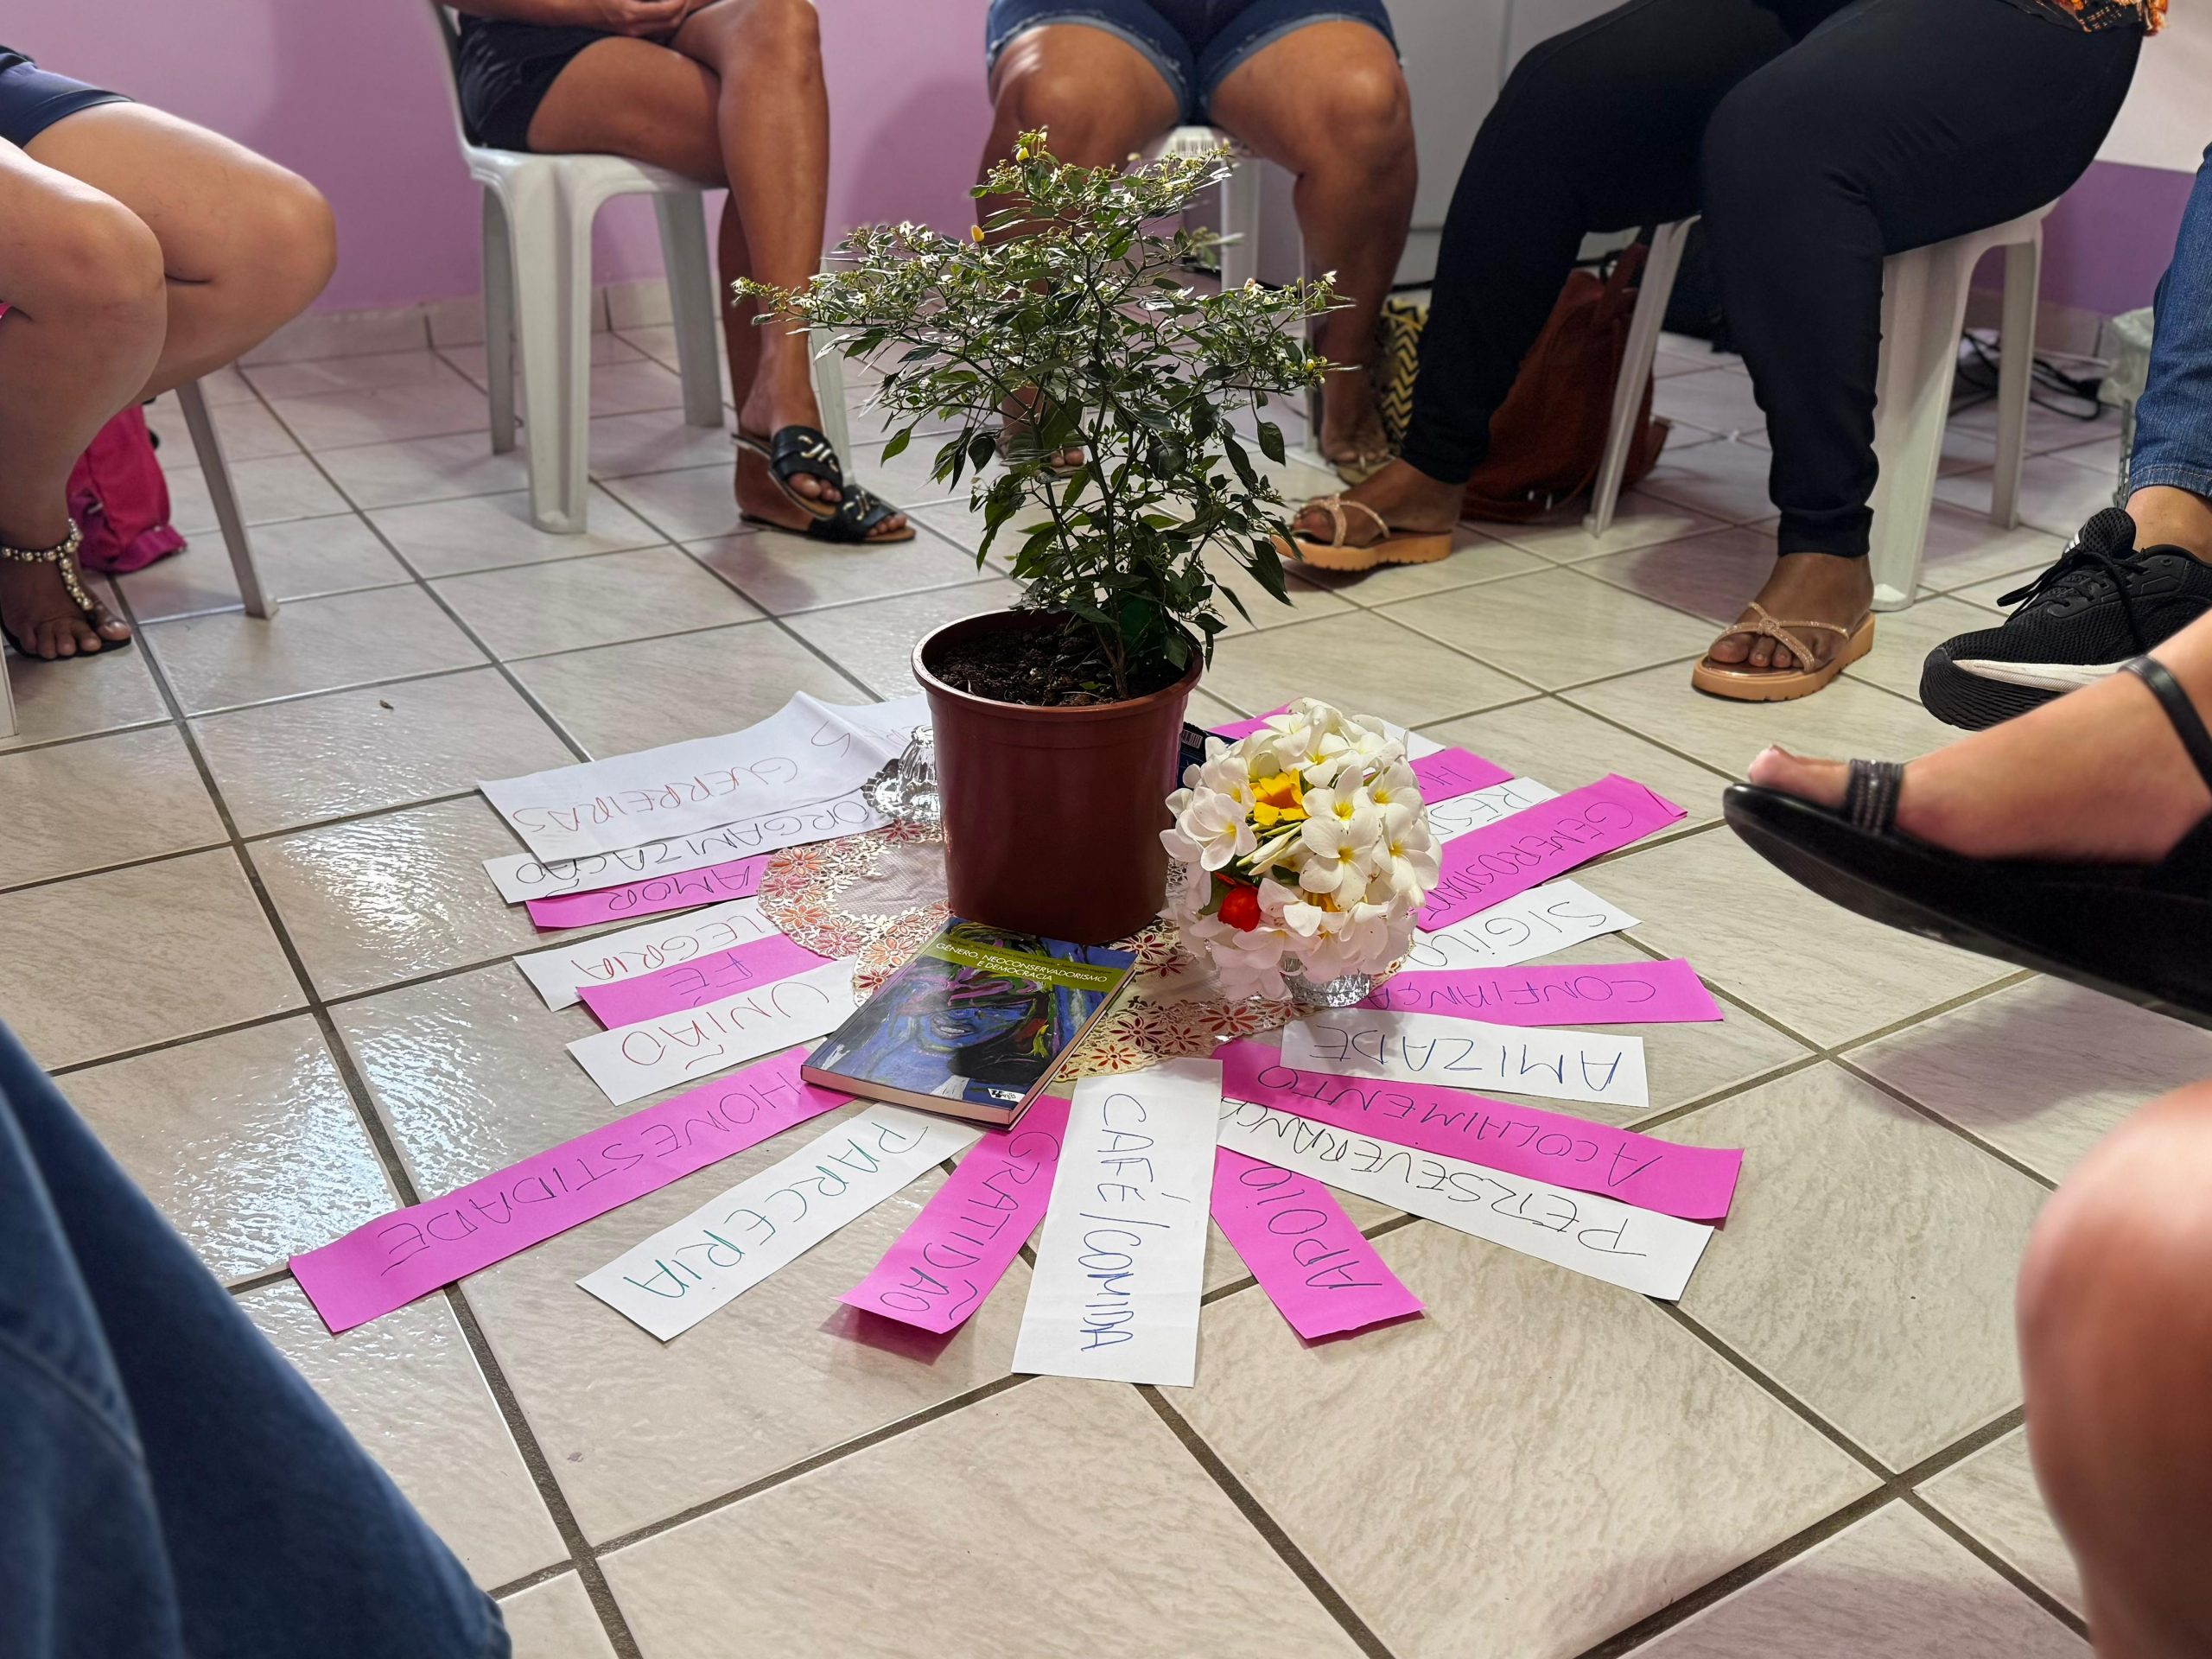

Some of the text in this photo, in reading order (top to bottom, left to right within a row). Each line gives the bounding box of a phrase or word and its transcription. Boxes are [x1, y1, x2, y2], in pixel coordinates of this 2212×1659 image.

[513, 757, 798, 833] GUERREIRAS
[594, 865, 751, 911] AMOR
[664, 952, 753, 1005] FÉ
[936, 942, 979, 959] GÊNERO,
[982, 954, 1108, 982] NEOCONSERVADORISMO
[984, 962, 1053, 982] DEMOCRACIA
[1367, 976, 1656, 1009] CONFIANÇA
[622, 982, 829, 1070] UNIÃO
[1310, 1025, 1622, 1092] AMIZADE
[1258, 1065, 1663, 1186] ACOLHIMENTO
[378, 1071, 801, 1275] HONESTIDADE
[623, 1122, 928, 1298] PARCERIA
[880, 1132, 1060, 1321] GRATIDÃO
[1240, 1166, 1383, 1290] APOIO
